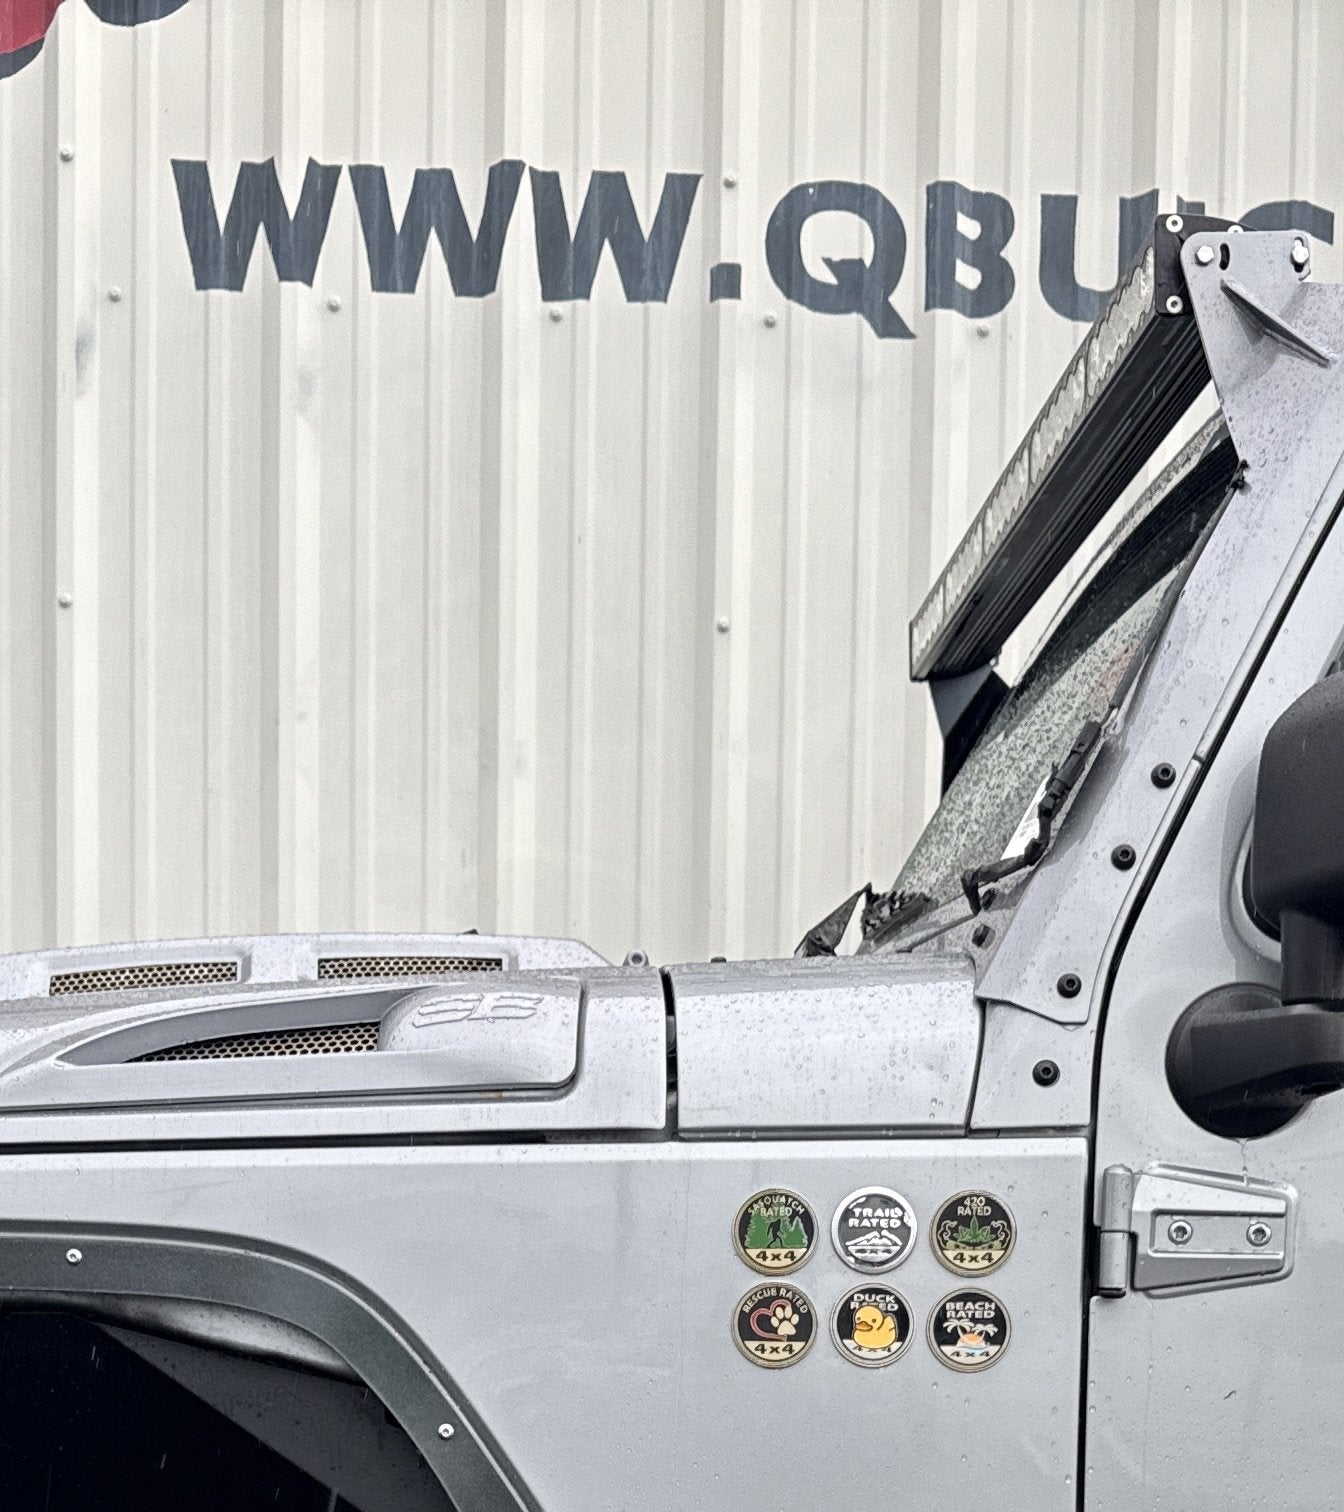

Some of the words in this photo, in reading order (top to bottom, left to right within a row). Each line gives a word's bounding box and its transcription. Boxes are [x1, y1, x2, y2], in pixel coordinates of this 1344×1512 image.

[747, 1195, 806, 1216] SASQUATCH
[963, 1196, 986, 1207] 420
[760, 1206, 793, 1217] RATED
[852, 1207, 901, 1218] TRAIL
[957, 1206, 992, 1217] RATED
[848, 1218, 901, 1229] RATED
[755, 1250, 796, 1262] 4x4
[953, 1252, 994, 1263] 4x4
[742, 1287, 778, 1314] RESCUE
[779, 1287, 809, 1314] RATED
[853, 1293, 896, 1304] DUCK
[849, 1301, 899, 1312] RED
[945, 1300, 996, 1311] BEACH
[946, 1310, 996, 1319] RATED
[754, 1343, 795, 1354] 4x4
